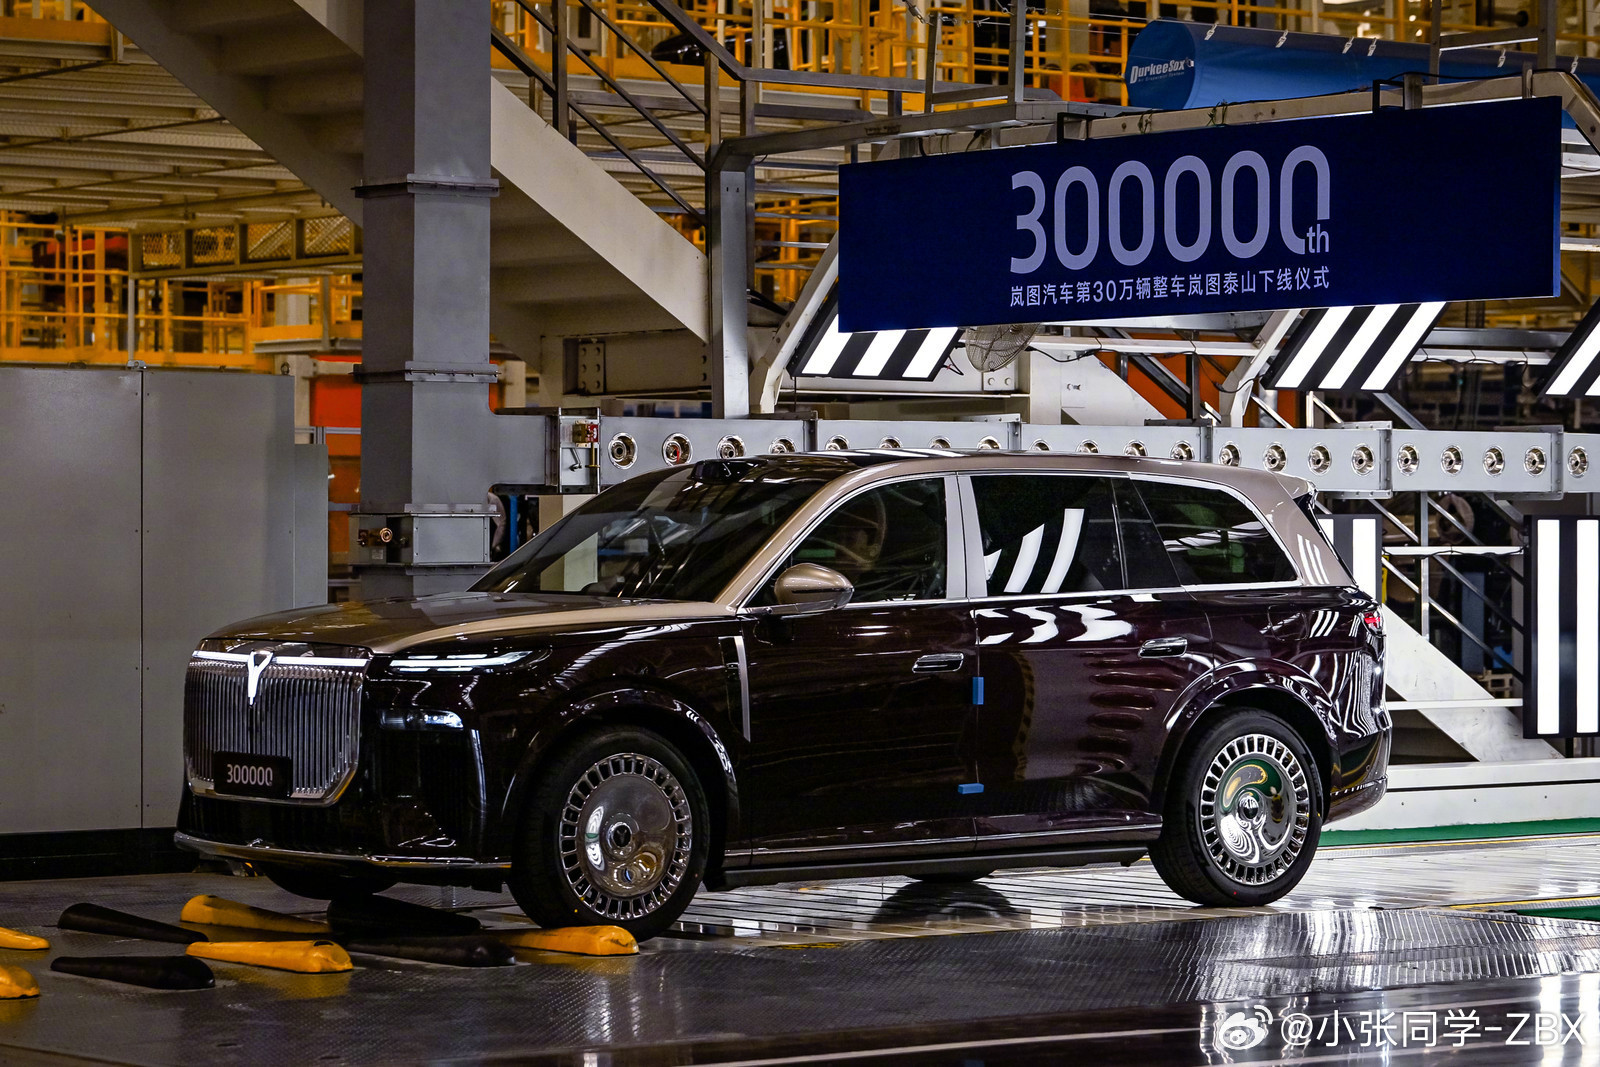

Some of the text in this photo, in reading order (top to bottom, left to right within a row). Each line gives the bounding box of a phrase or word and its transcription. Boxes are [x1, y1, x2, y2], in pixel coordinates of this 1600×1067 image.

[1129, 59, 1186, 84] DurkeeSox
[1010, 265, 1330, 307] 岚图汽车第30万辆整车岚图泰山下线仪式
